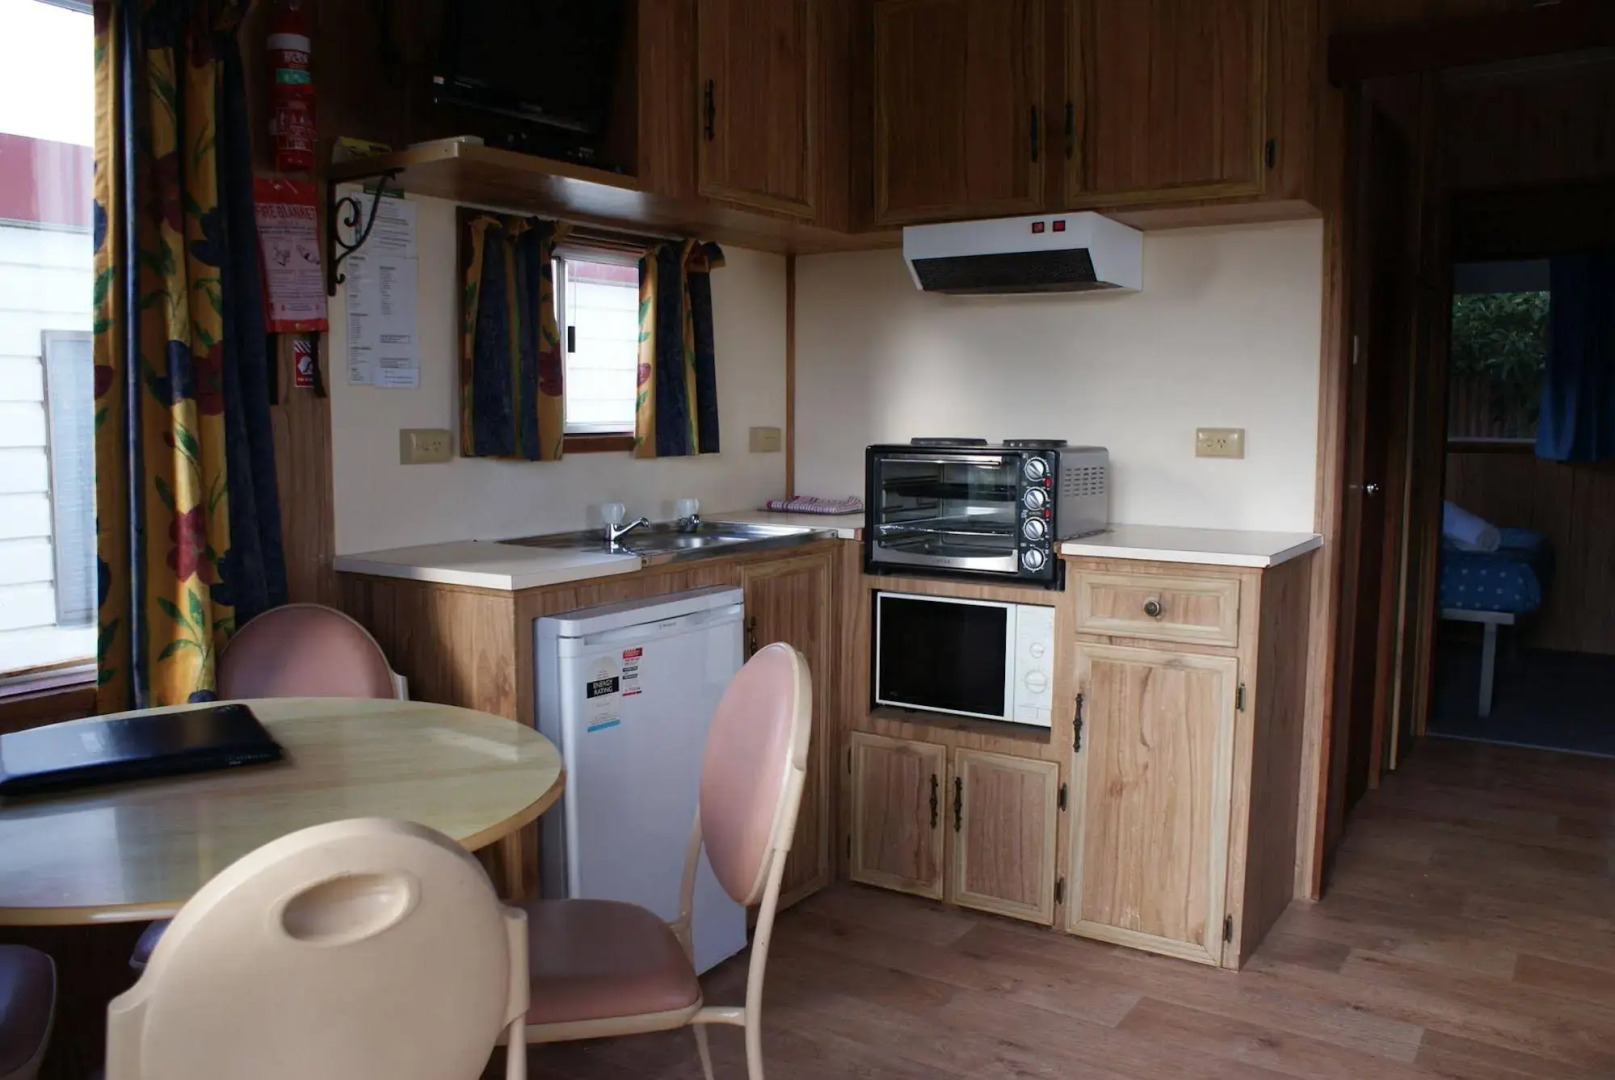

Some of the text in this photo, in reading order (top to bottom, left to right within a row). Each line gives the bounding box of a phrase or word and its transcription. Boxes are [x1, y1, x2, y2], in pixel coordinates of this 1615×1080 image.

[256, 204, 314, 220] FIRE BLANKET
[593, 680, 613, 689] ENERGY
[594, 686, 613, 696] RATING
